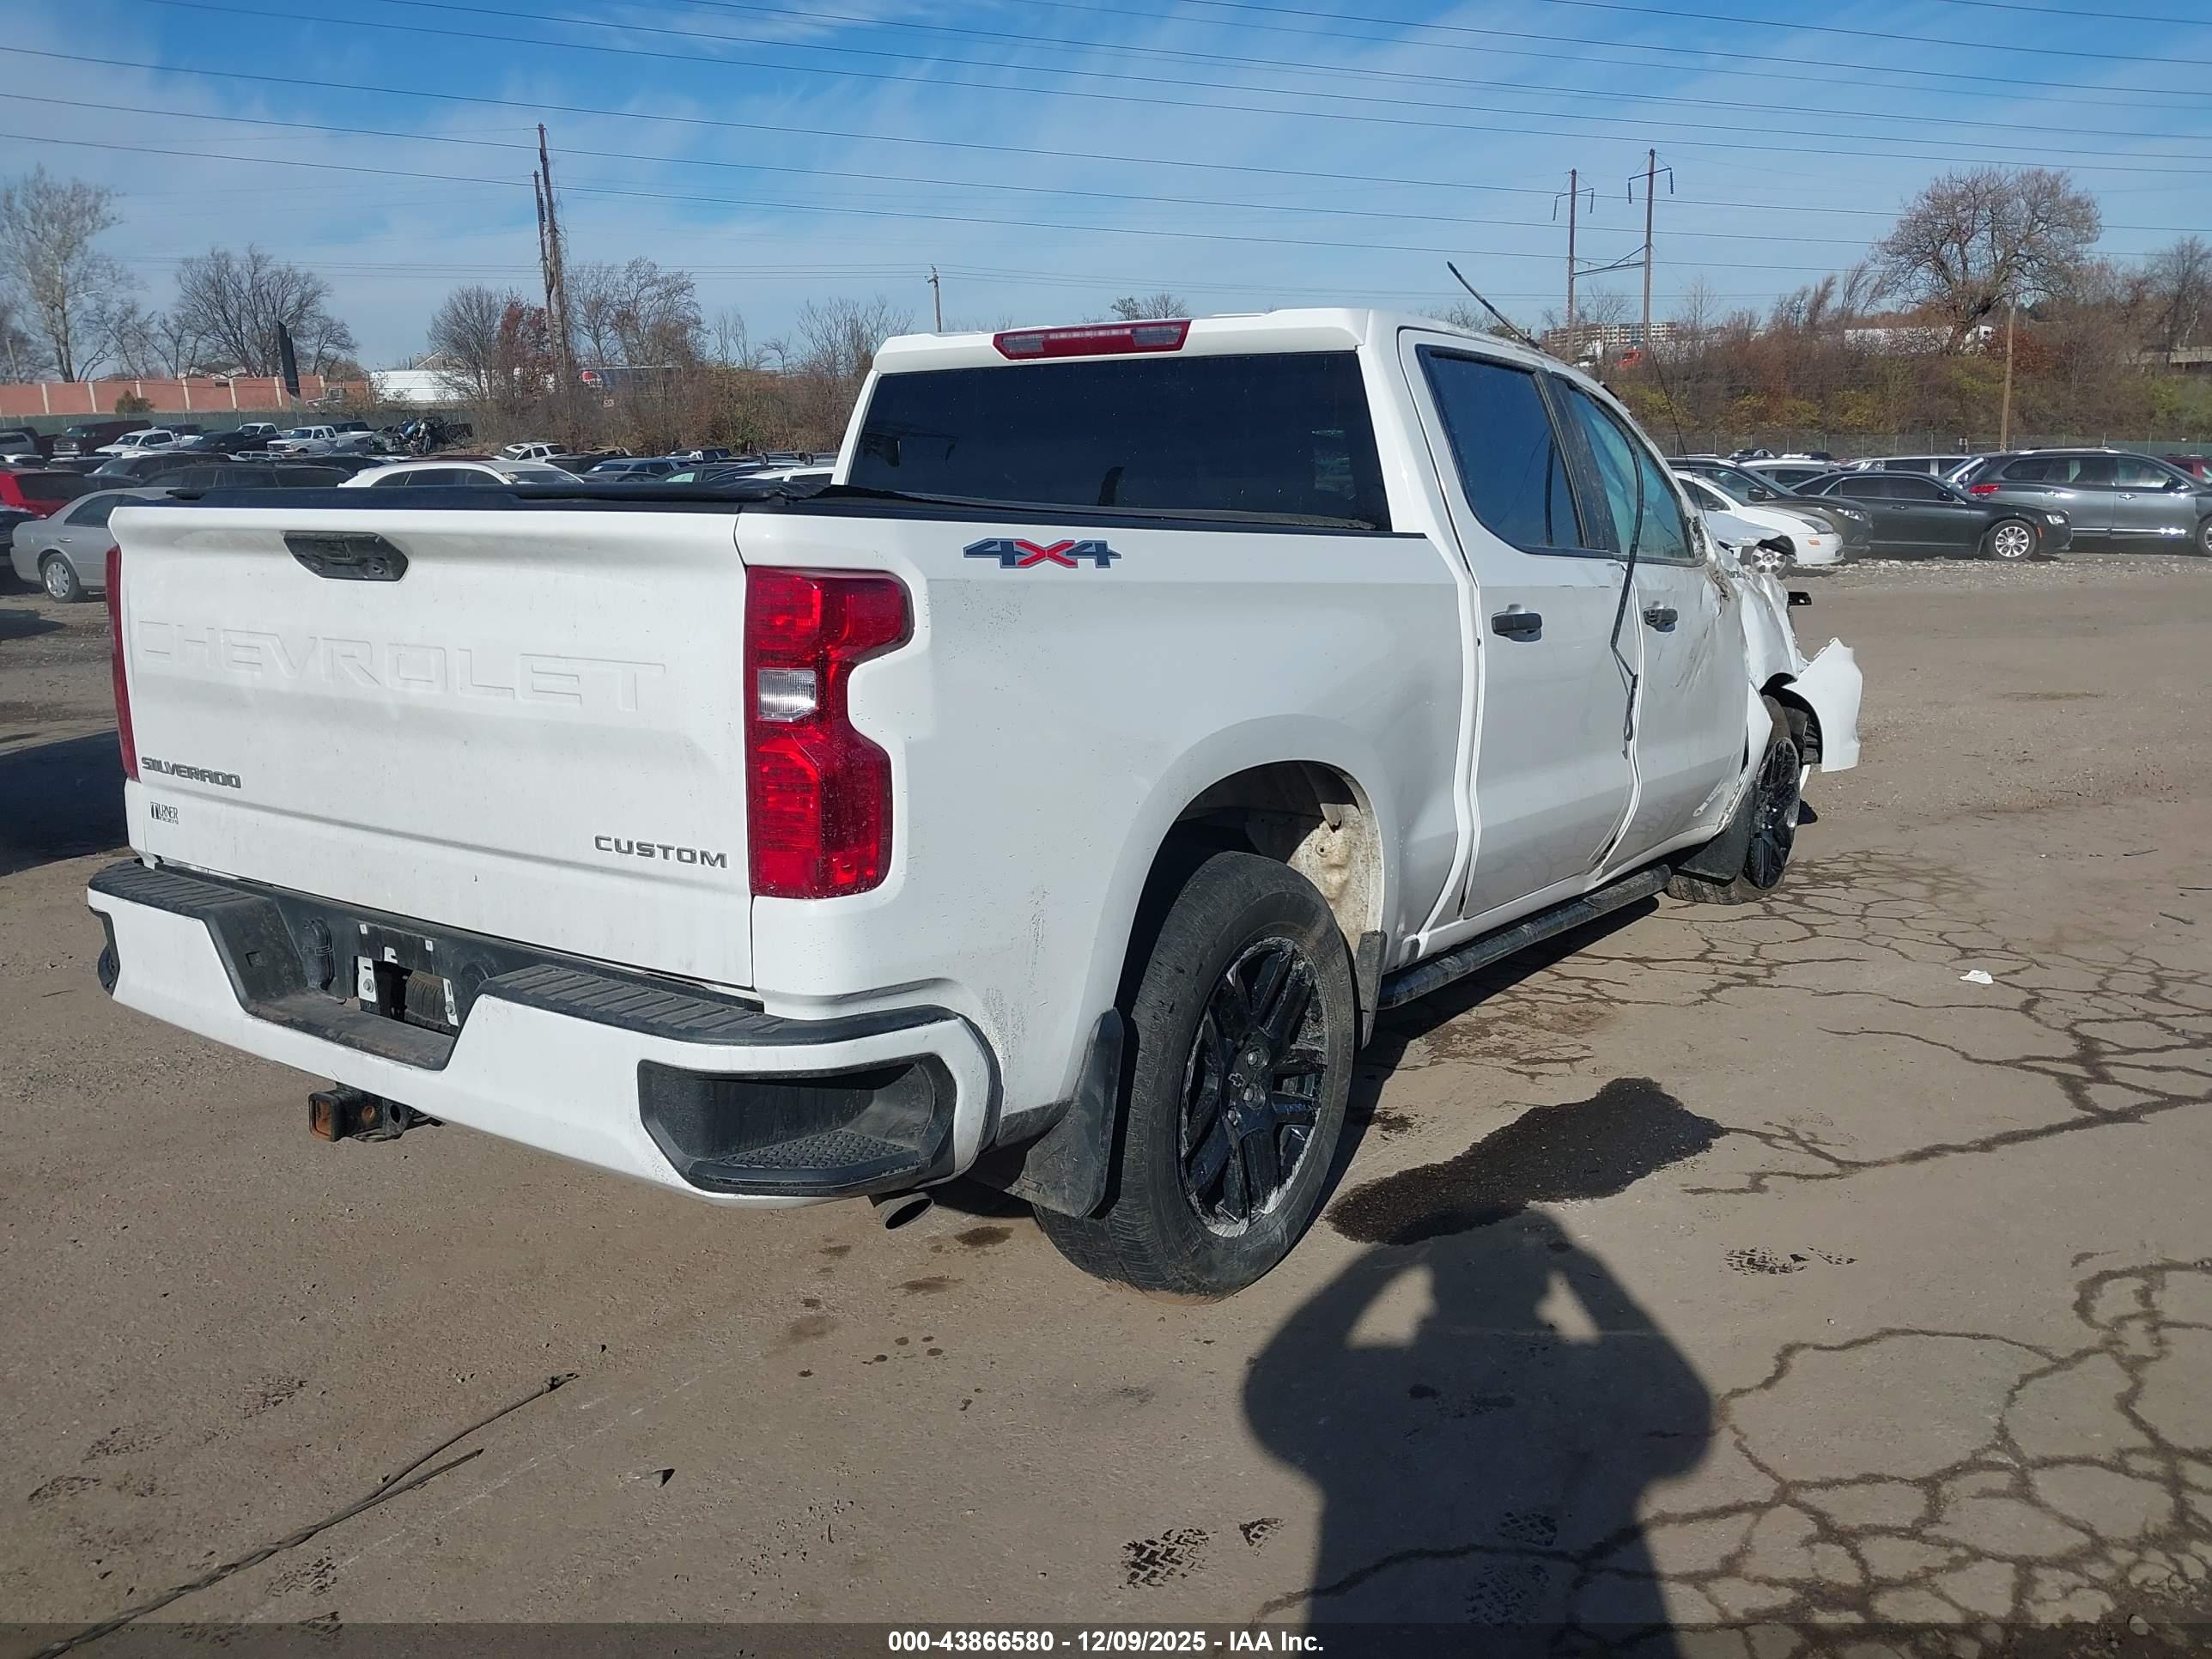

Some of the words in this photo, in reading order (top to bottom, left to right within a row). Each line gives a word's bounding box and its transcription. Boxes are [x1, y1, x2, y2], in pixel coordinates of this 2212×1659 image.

[137, 620, 665, 712] CHEVROLET
[141, 757, 241, 789] SILVERADO
[594, 835, 728, 869] CUSTOM
